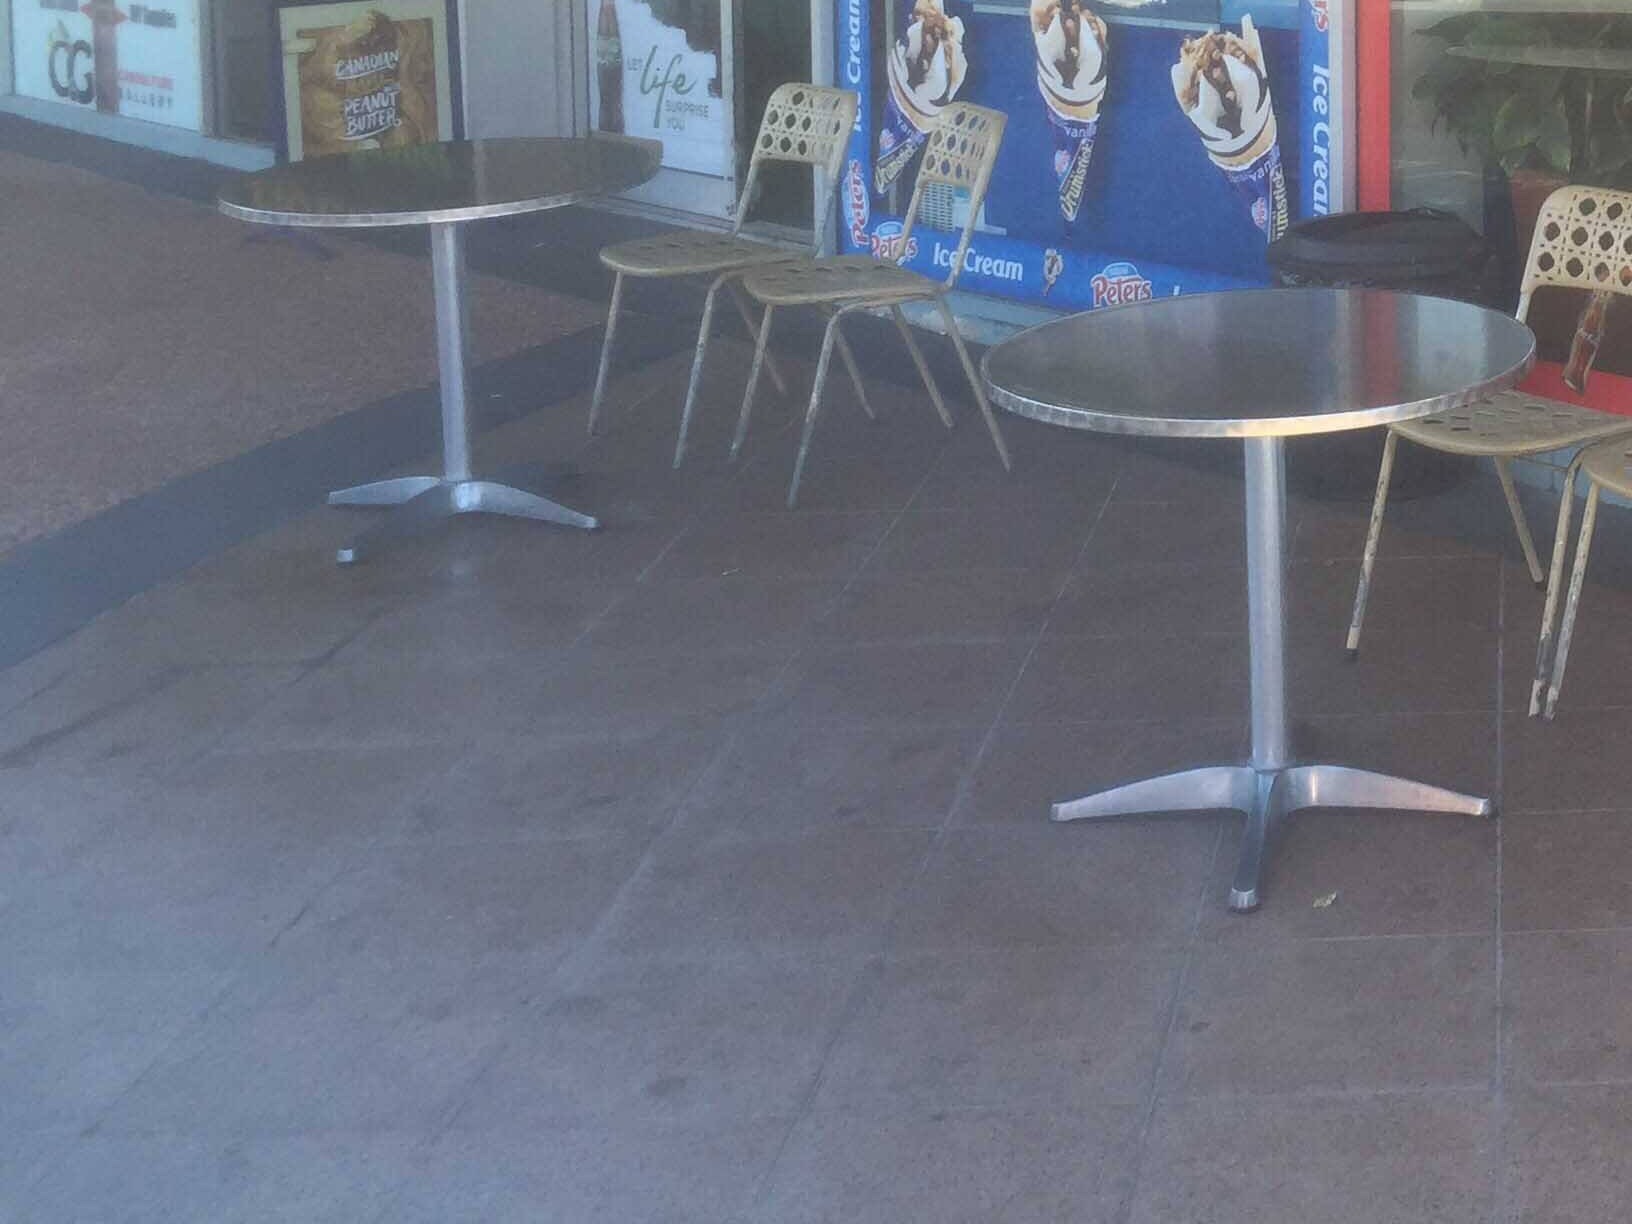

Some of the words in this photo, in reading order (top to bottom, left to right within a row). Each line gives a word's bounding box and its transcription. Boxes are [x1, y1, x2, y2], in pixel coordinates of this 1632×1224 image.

[344, 89, 399, 114] PEANUT
[639, 45, 698, 129] life
[1312, 63, 1329, 116] Ice
[962, 248, 1023, 281] Cream
[1091, 273, 1152, 308] Peters
